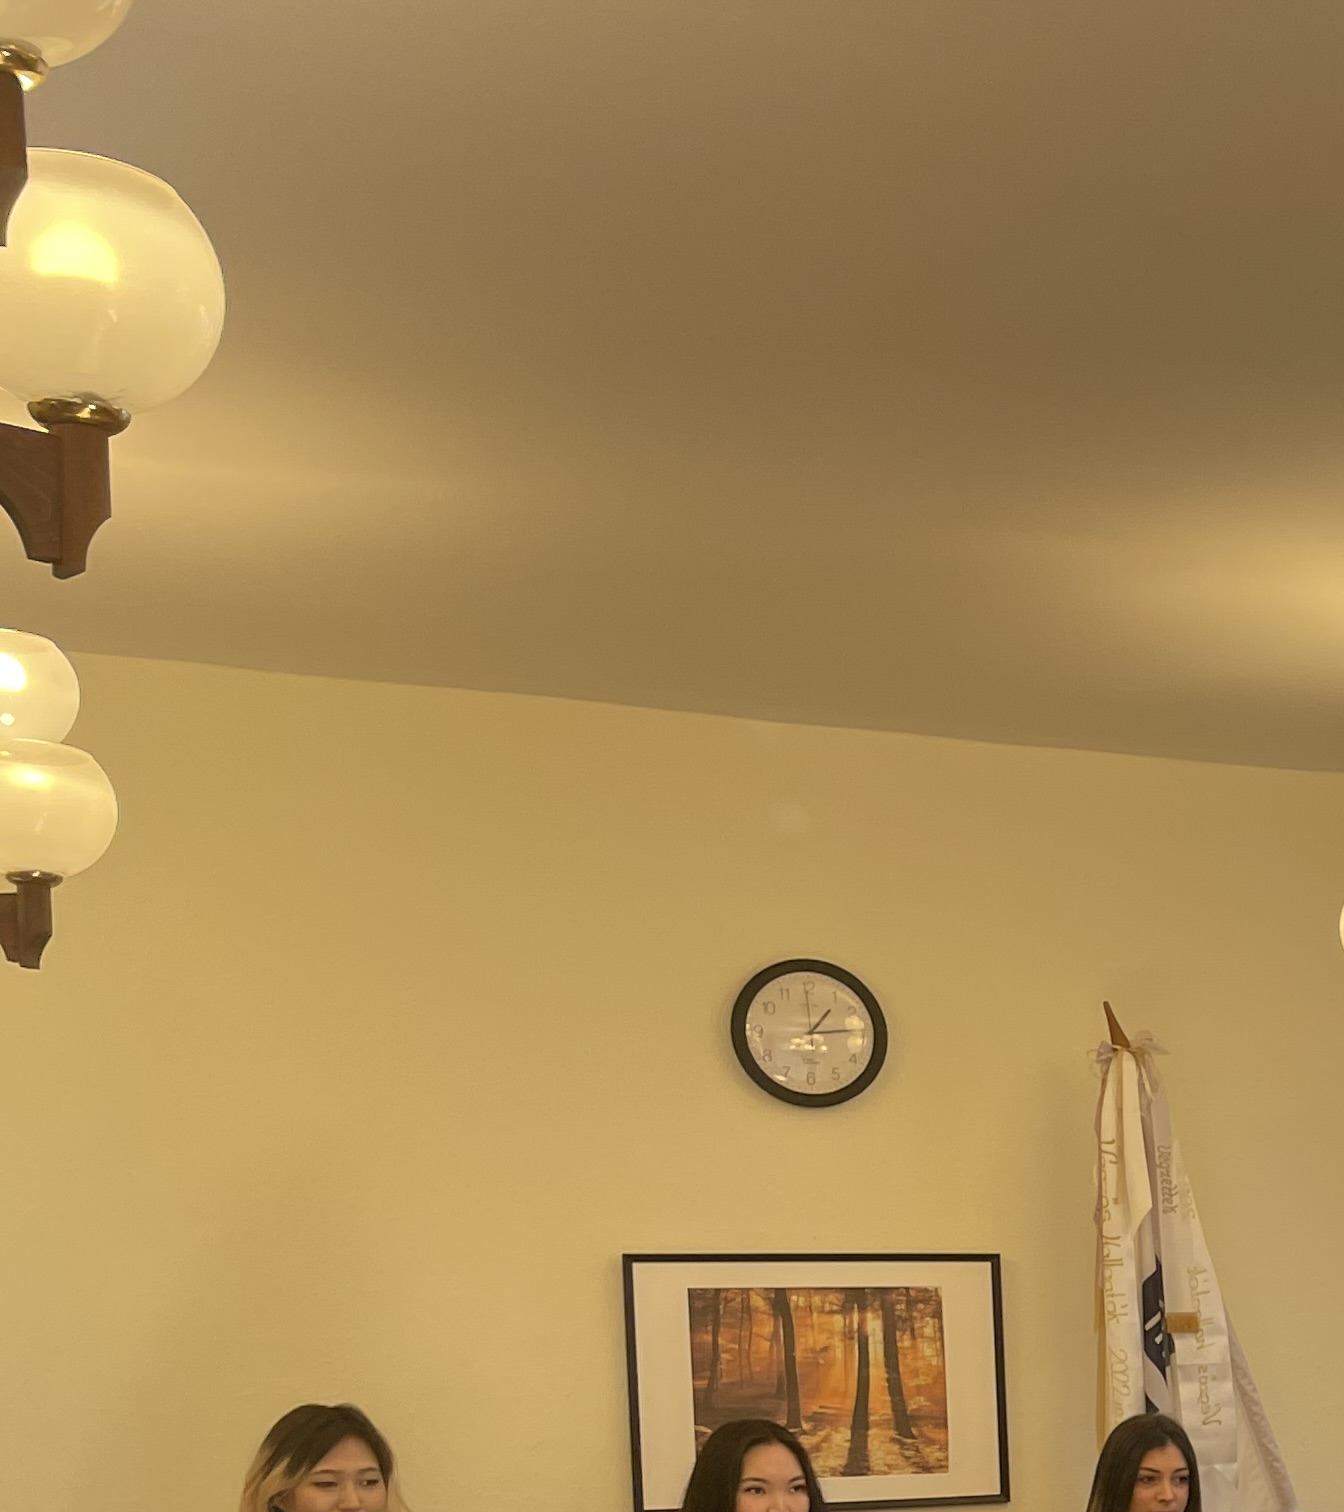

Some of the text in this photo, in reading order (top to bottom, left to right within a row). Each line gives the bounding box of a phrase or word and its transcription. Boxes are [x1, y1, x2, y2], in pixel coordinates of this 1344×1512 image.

[780, 988, 790, 1000] 11
[832, 991, 837, 1002] 1
[763, 1002, 776, 1015] 10
[753, 1025, 763, 1038] 9
[849, 1054, 857, 1064] 4
[806, 1072, 816, 1085] 6
[832, 1067, 840, 1081] 5
